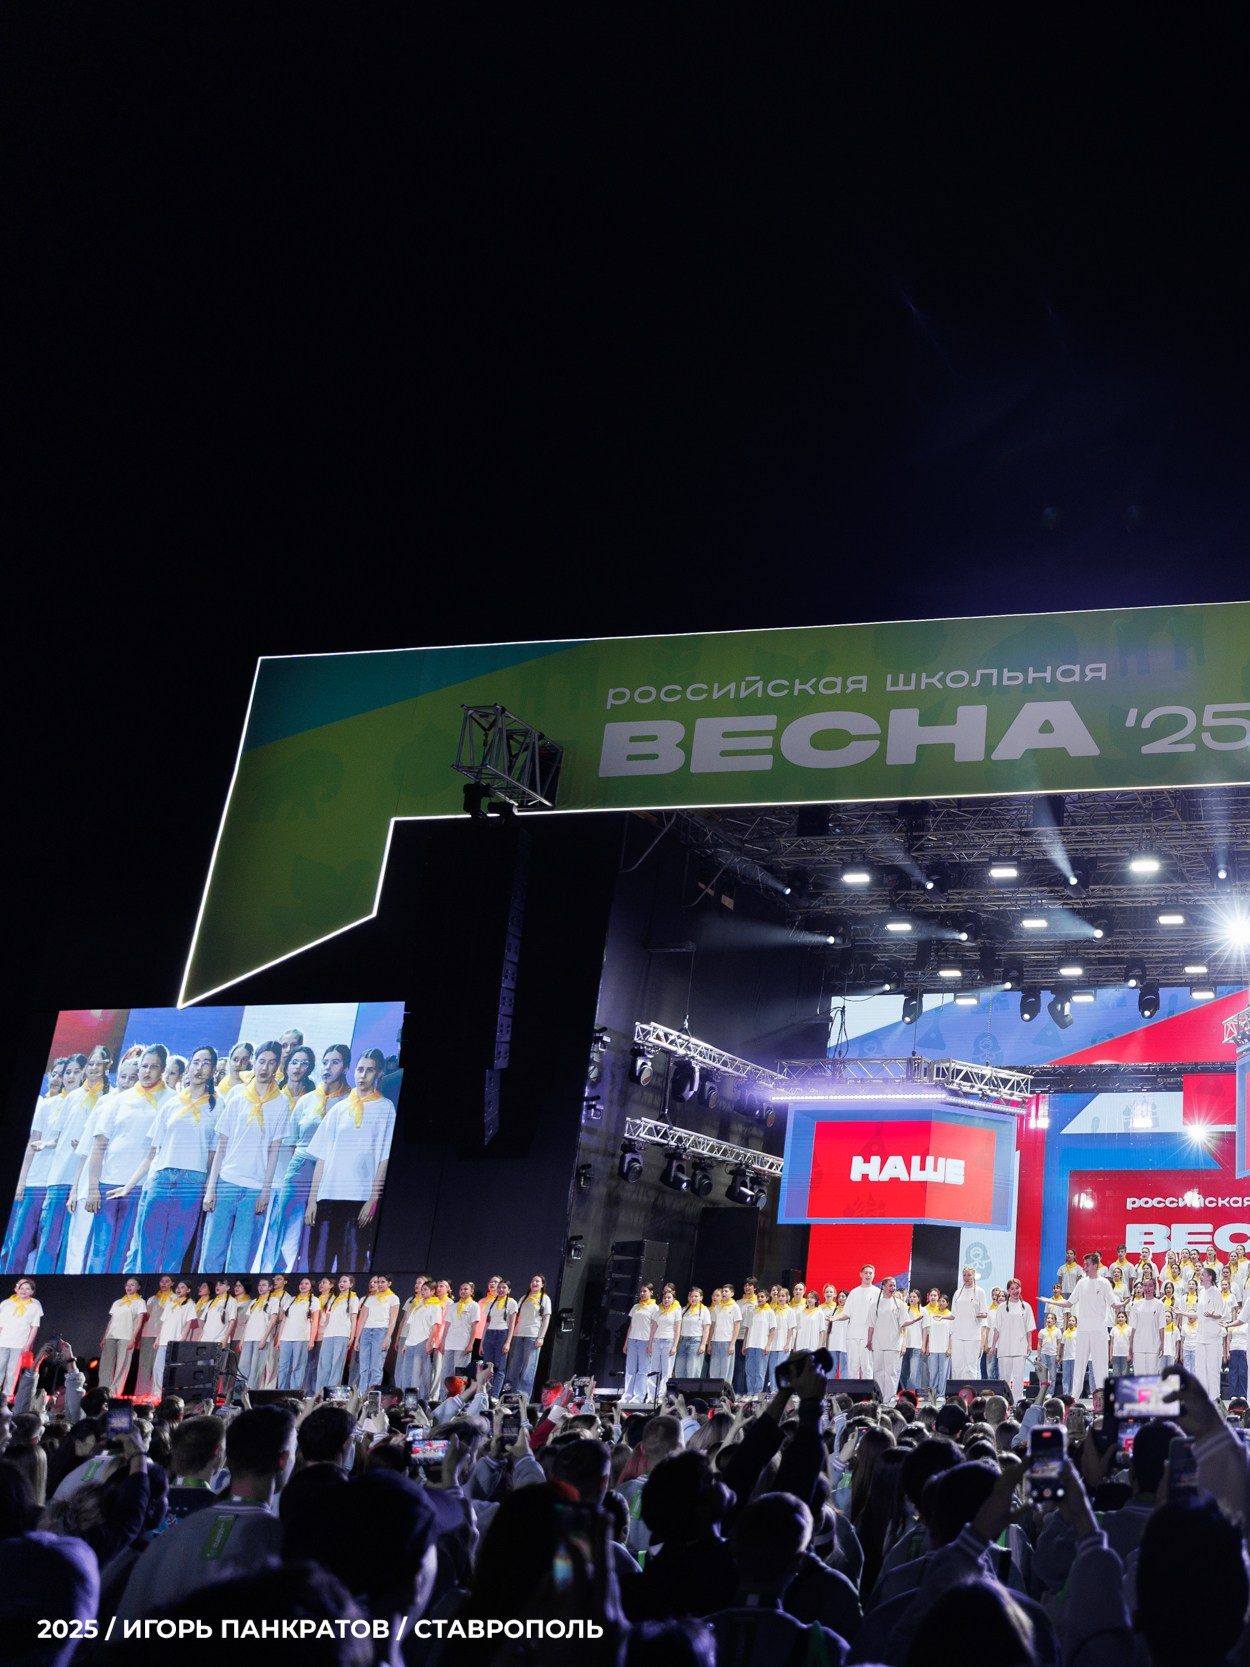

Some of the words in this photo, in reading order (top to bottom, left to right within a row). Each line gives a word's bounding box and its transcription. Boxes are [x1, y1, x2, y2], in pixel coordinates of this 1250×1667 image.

[607, 674, 867, 709] российская
[886, 662, 1107, 692] школьная
[598, 701, 1100, 777] ВЕСНА
[850, 1155, 965, 1185] НАШЕ
